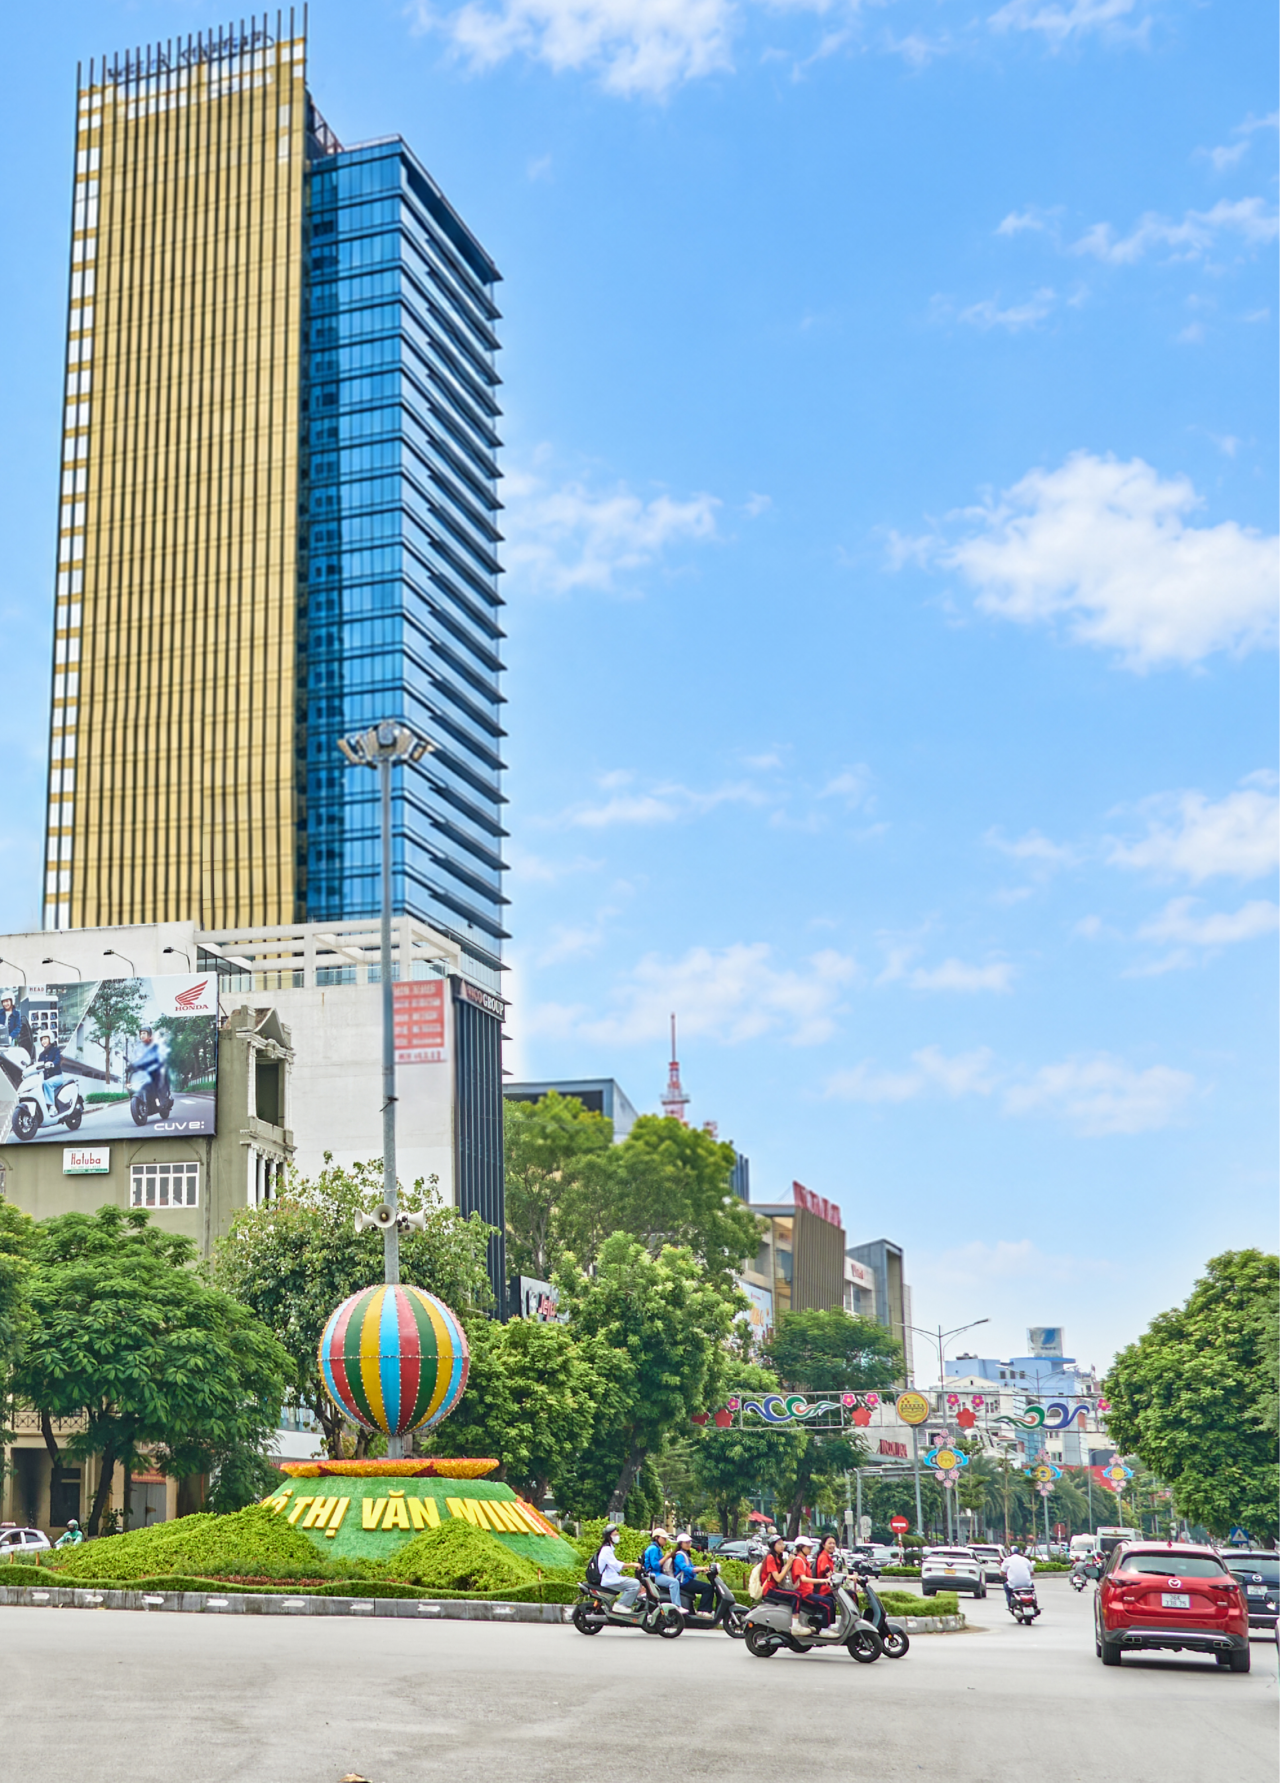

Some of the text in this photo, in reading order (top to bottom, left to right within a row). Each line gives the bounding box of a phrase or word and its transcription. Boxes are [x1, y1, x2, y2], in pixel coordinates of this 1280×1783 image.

[174, 1003, 209, 1012] HONDA
[154, 1122, 187, 1131] CUV
[70, 1152, 101, 1165] Hatuba
[287, 1496, 350, 1539] THỊ
[361, 1490, 442, 1532] VĂN
[445, 1497, 548, 1536] MINH
